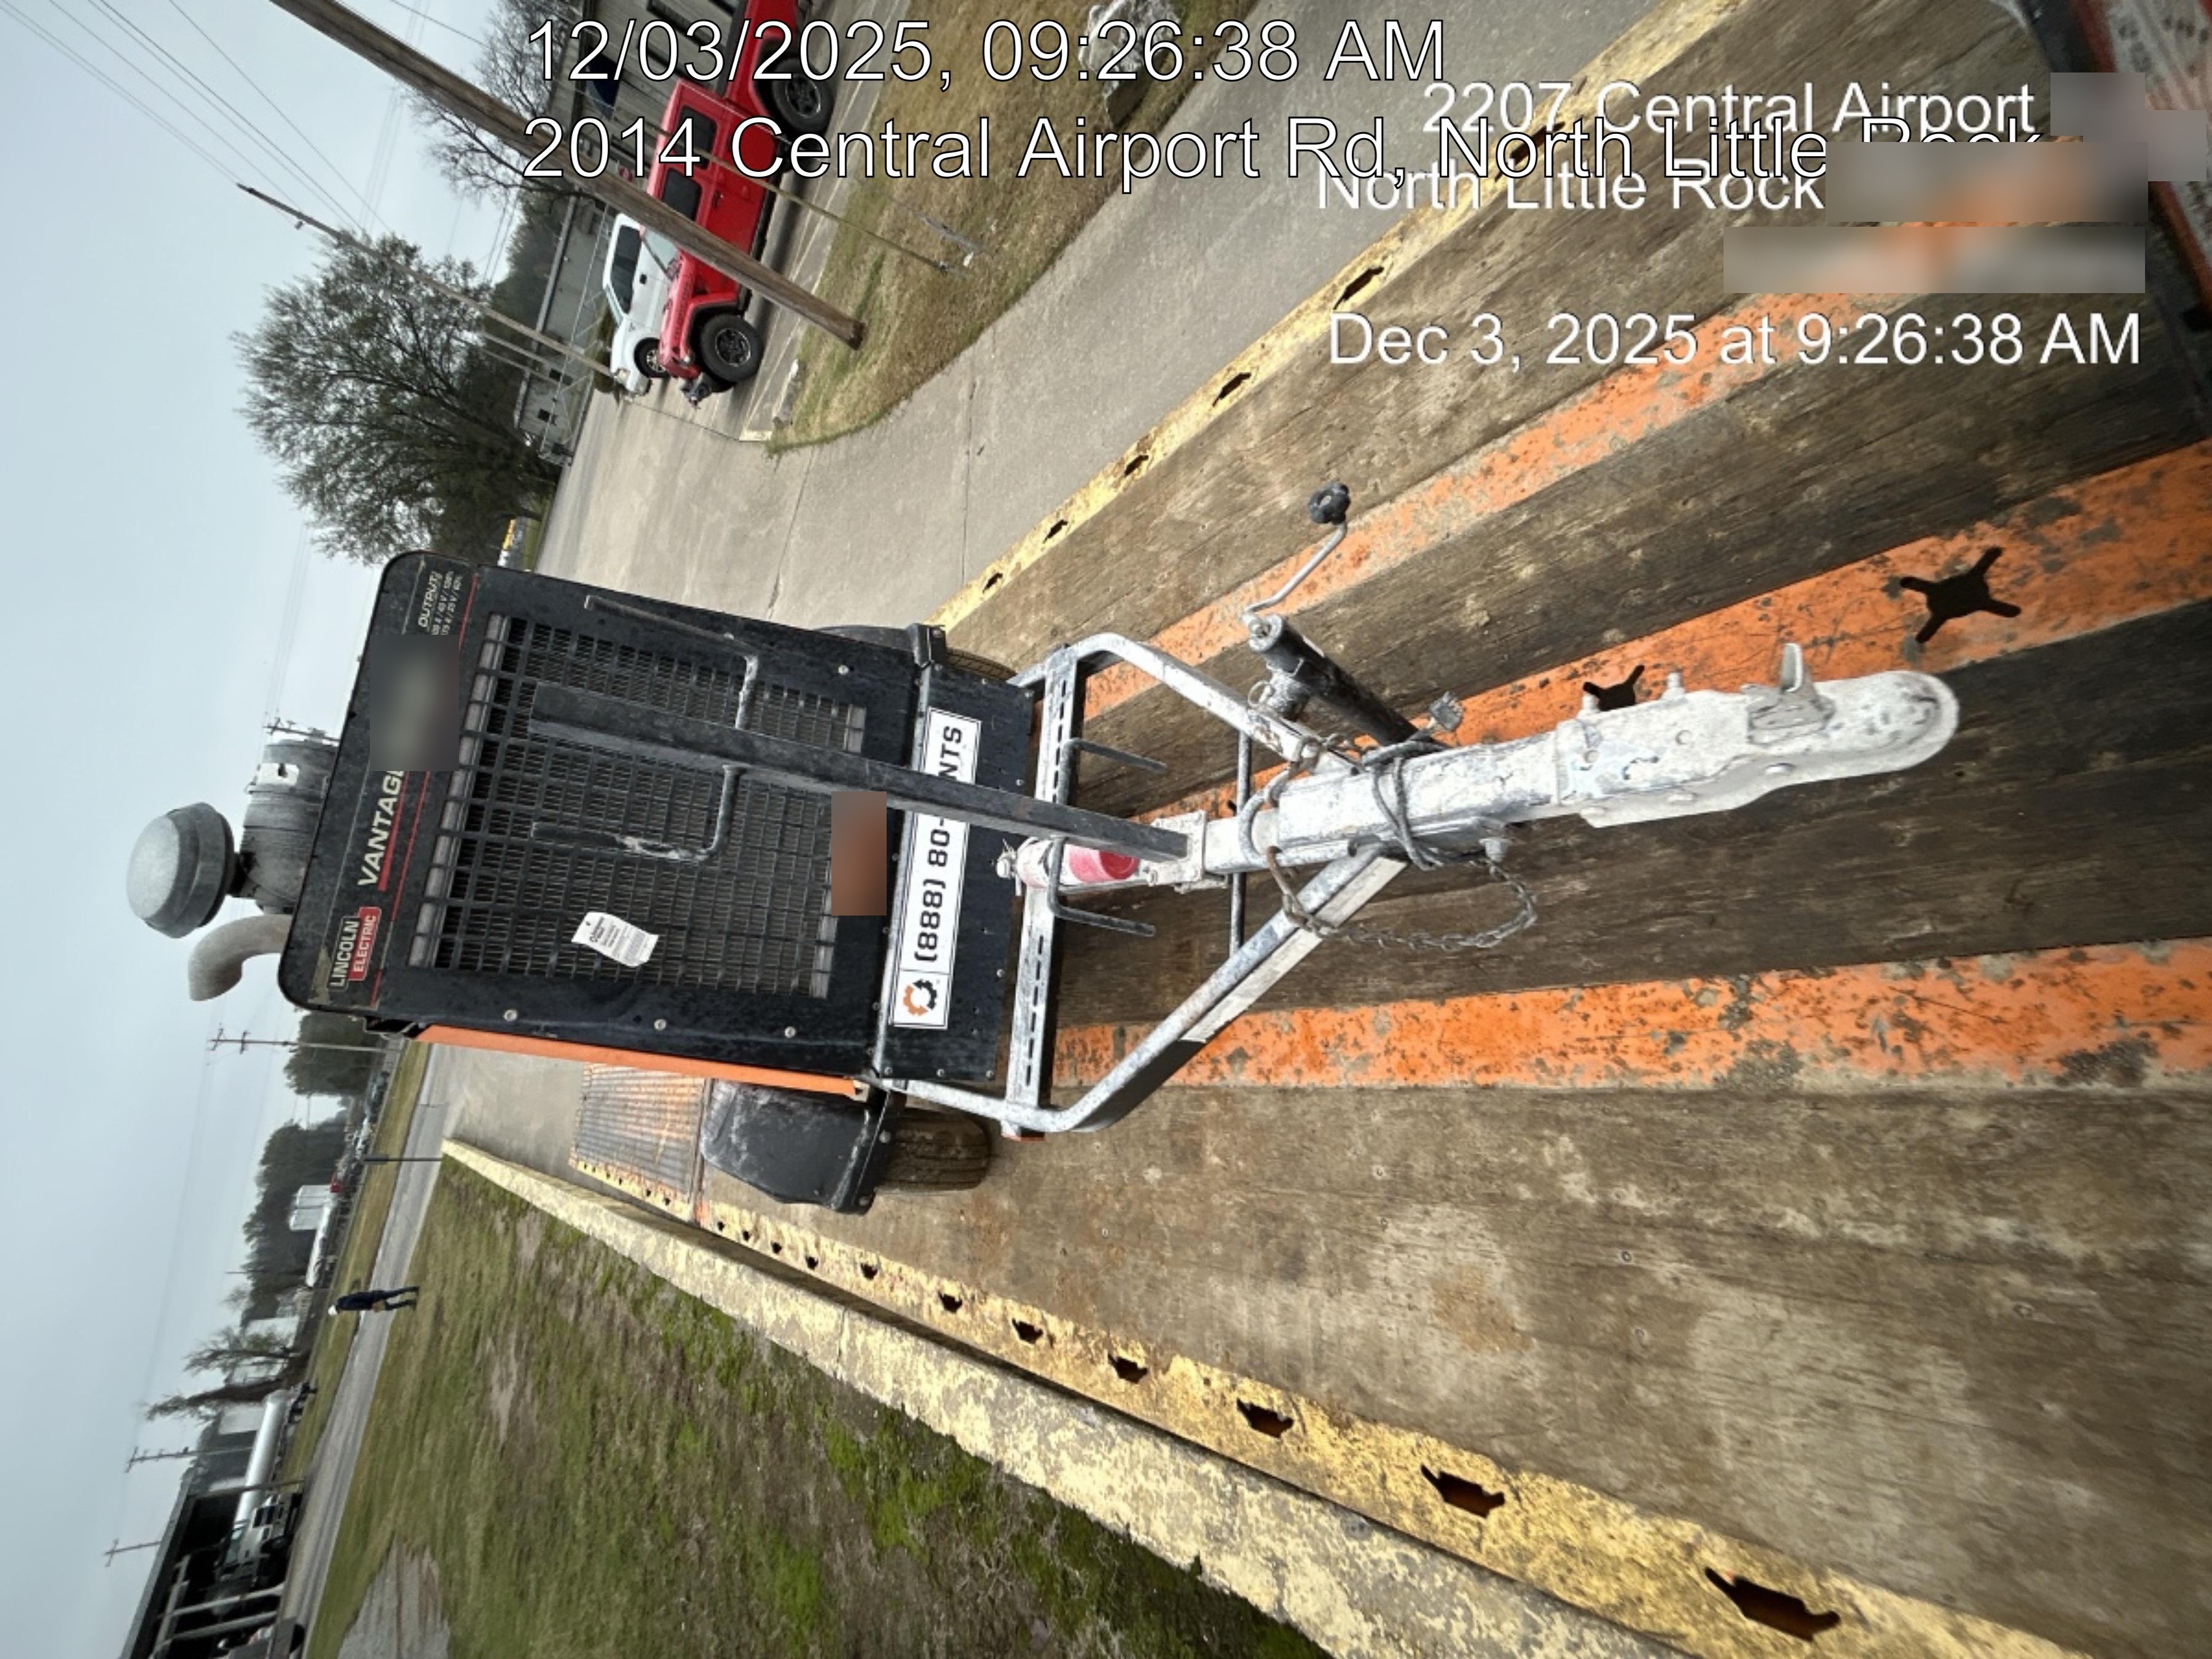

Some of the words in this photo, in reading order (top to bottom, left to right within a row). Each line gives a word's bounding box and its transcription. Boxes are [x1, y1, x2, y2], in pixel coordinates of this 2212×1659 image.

[331, 920, 359, 987] LINCOLN
[353, 914, 377, 972] ELECTRIC
[914, 878, 946, 963] (888)
